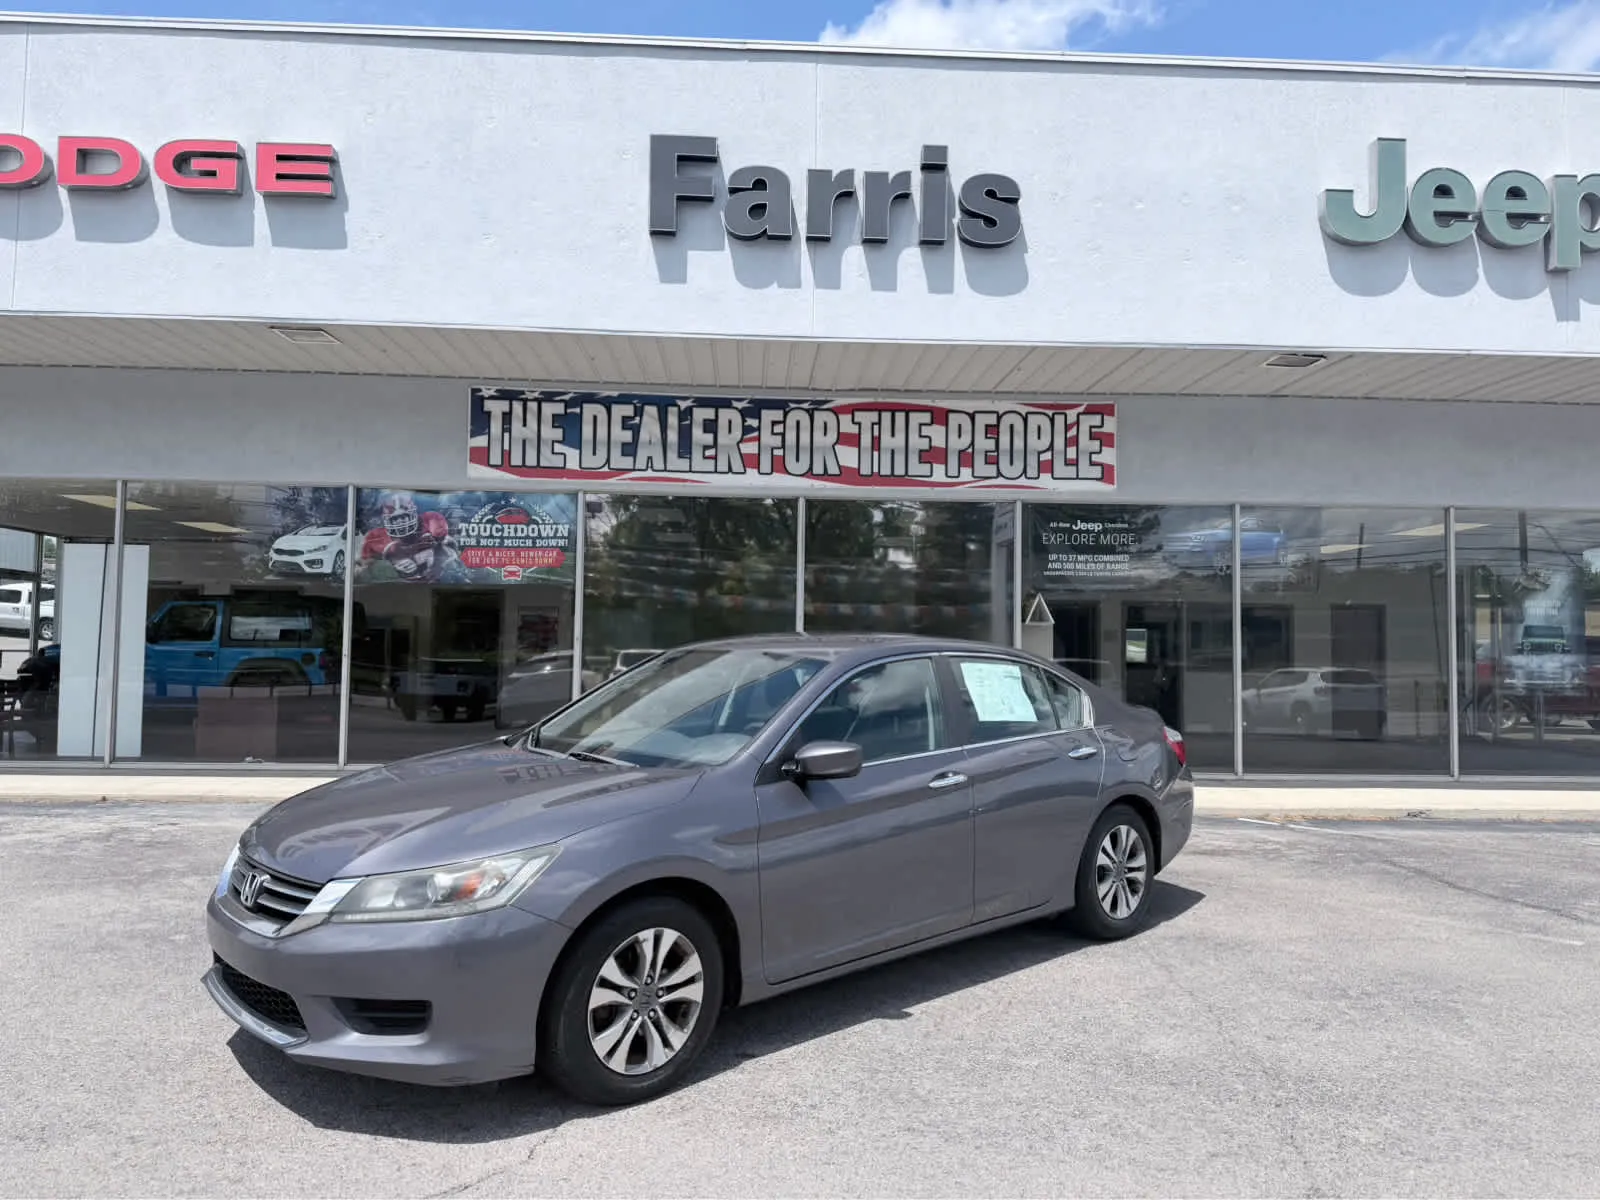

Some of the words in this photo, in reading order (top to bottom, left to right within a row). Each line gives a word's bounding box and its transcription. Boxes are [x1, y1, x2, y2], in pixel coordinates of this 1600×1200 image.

[650, 134, 1021, 248] Farris
[1318, 137, 1600, 272] Jeep
[482, 399, 568, 468] THE
[579, 401, 746, 475] DEALER
[758, 407, 841, 476] FOR
[851, 409, 934, 478] THE
[945, 409, 1105, 481] PEOPLE
[458, 523, 570, 537] TOUCHDOWN
[1072, 519, 1103, 532] Jeep
[460, 538, 478, 546] FOR
[480, 538, 500, 547] NOT
[503, 539, 533, 547] MUCH
[536, 539, 569, 547] DOWN!
[1042, 533, 1097, 545] EXPLORE
[1100, 533, 1139, 545] MORE.
[1093, 554, 1130, 562] COMBINED
[1047, 562, 1062, 570] AND
